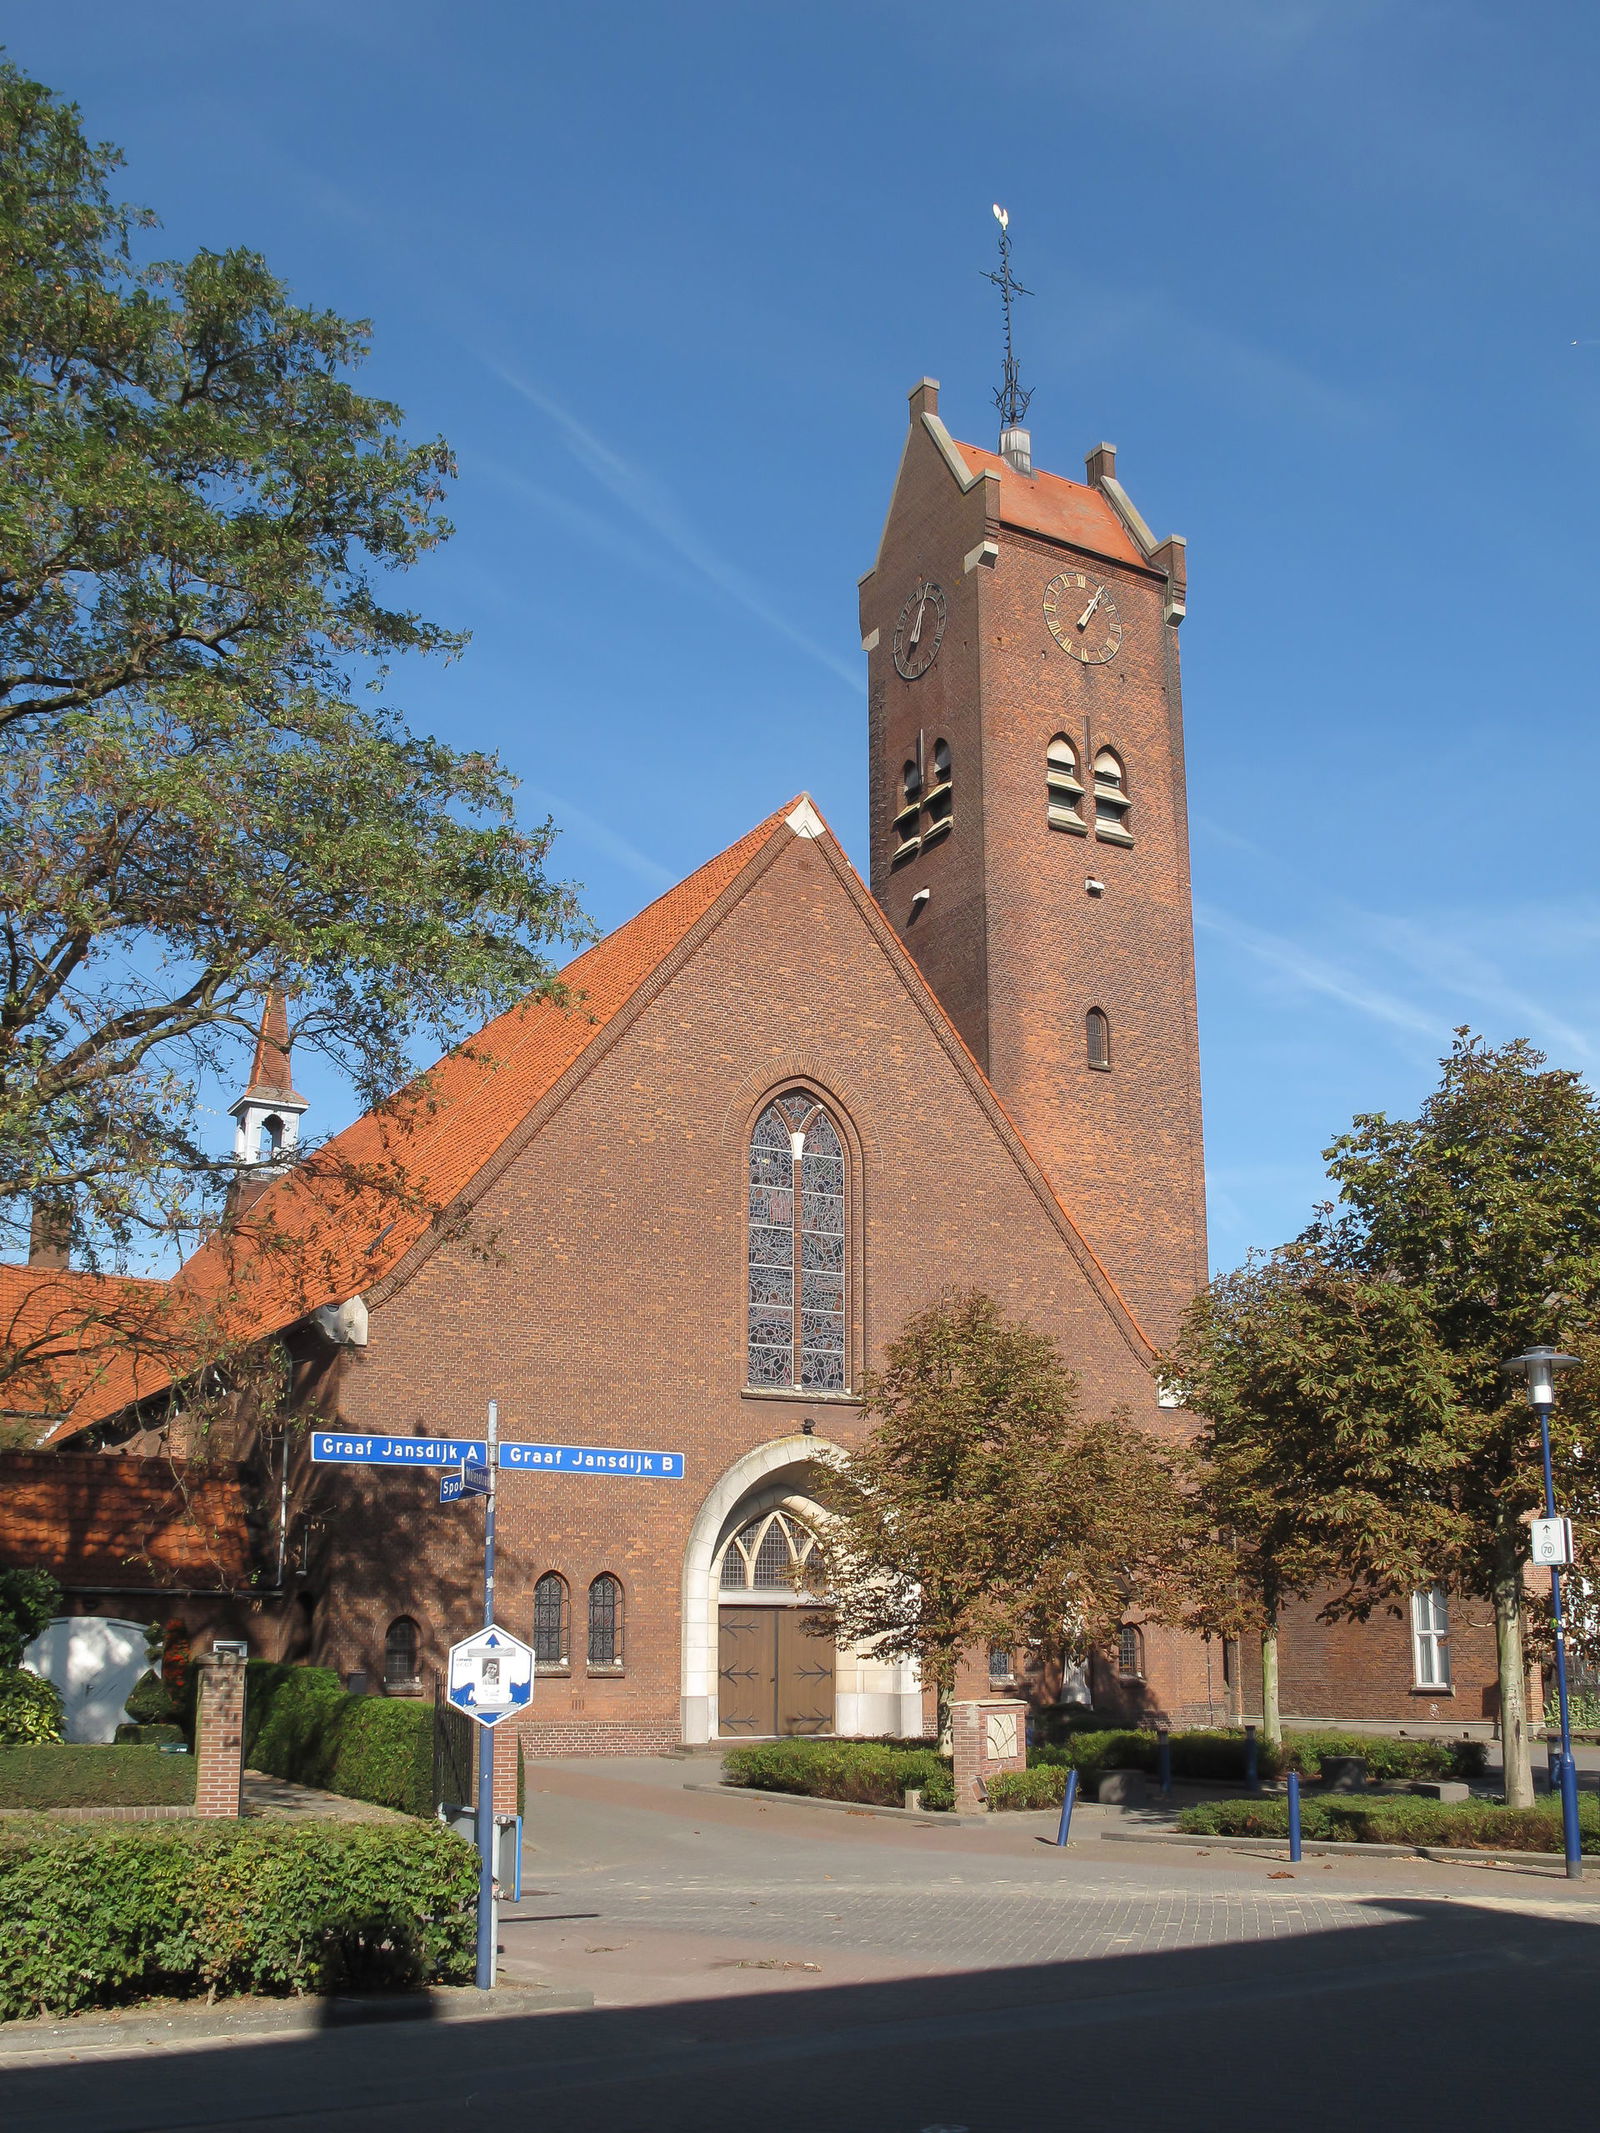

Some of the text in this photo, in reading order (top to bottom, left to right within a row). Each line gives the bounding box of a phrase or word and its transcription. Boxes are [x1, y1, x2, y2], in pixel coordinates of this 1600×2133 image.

[322, 1438, 479, 1463] Graaf Jansdijk A
[510, 1447, 673, 1473] Graaf Jansdijk B
[1543, 1546, 1553, 1554] 70
